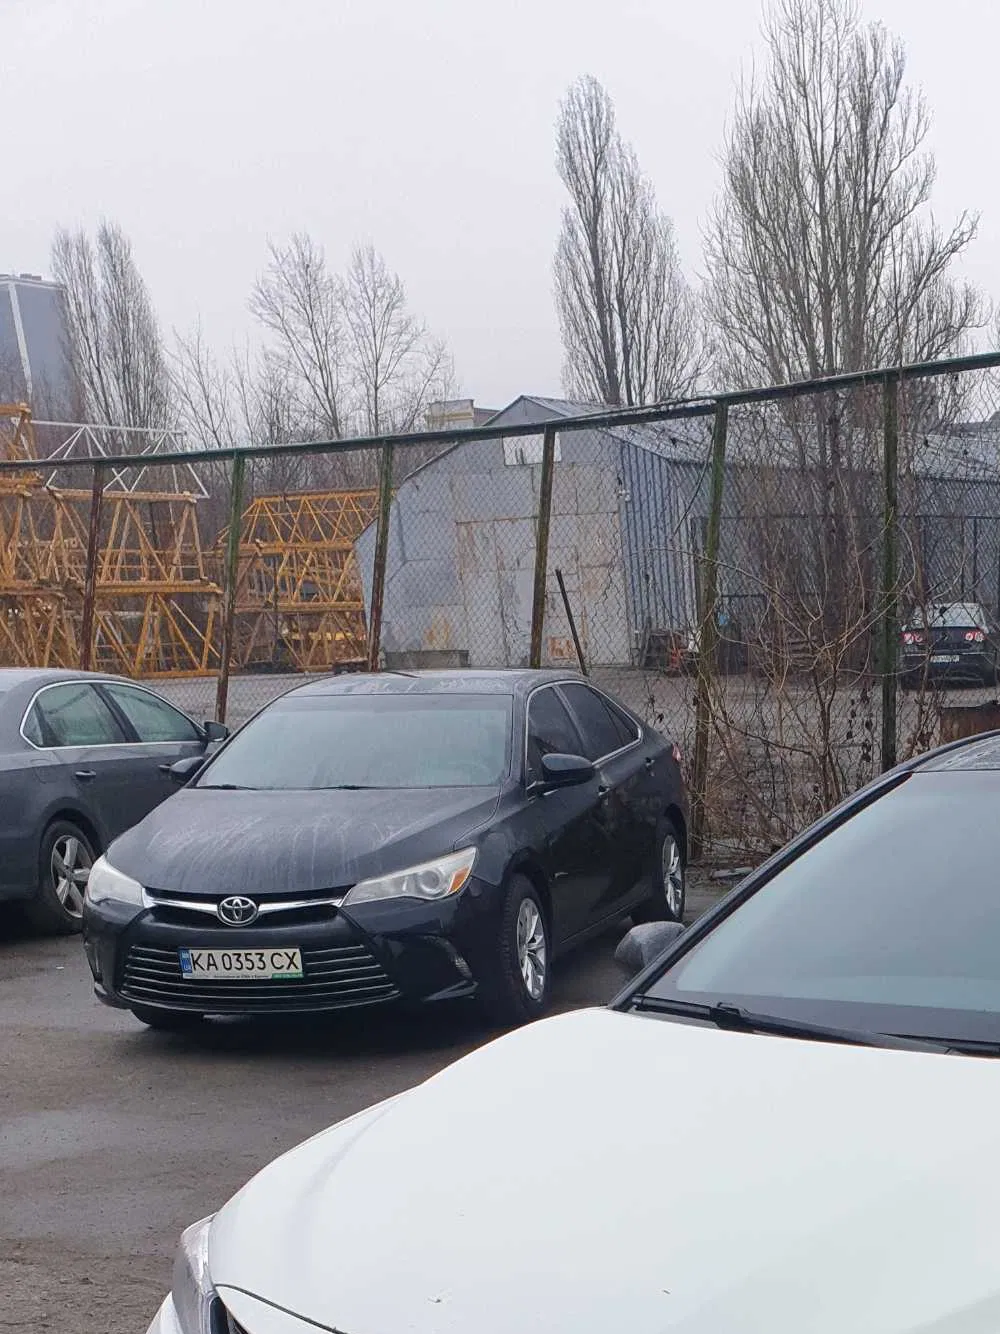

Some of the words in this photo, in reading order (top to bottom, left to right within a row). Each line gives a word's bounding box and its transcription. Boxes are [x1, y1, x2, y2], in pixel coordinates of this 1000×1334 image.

[191, 953, 219, 971] KA
[222, 952, 267, 971] 0353
[270, 952, 299, 970] CX
